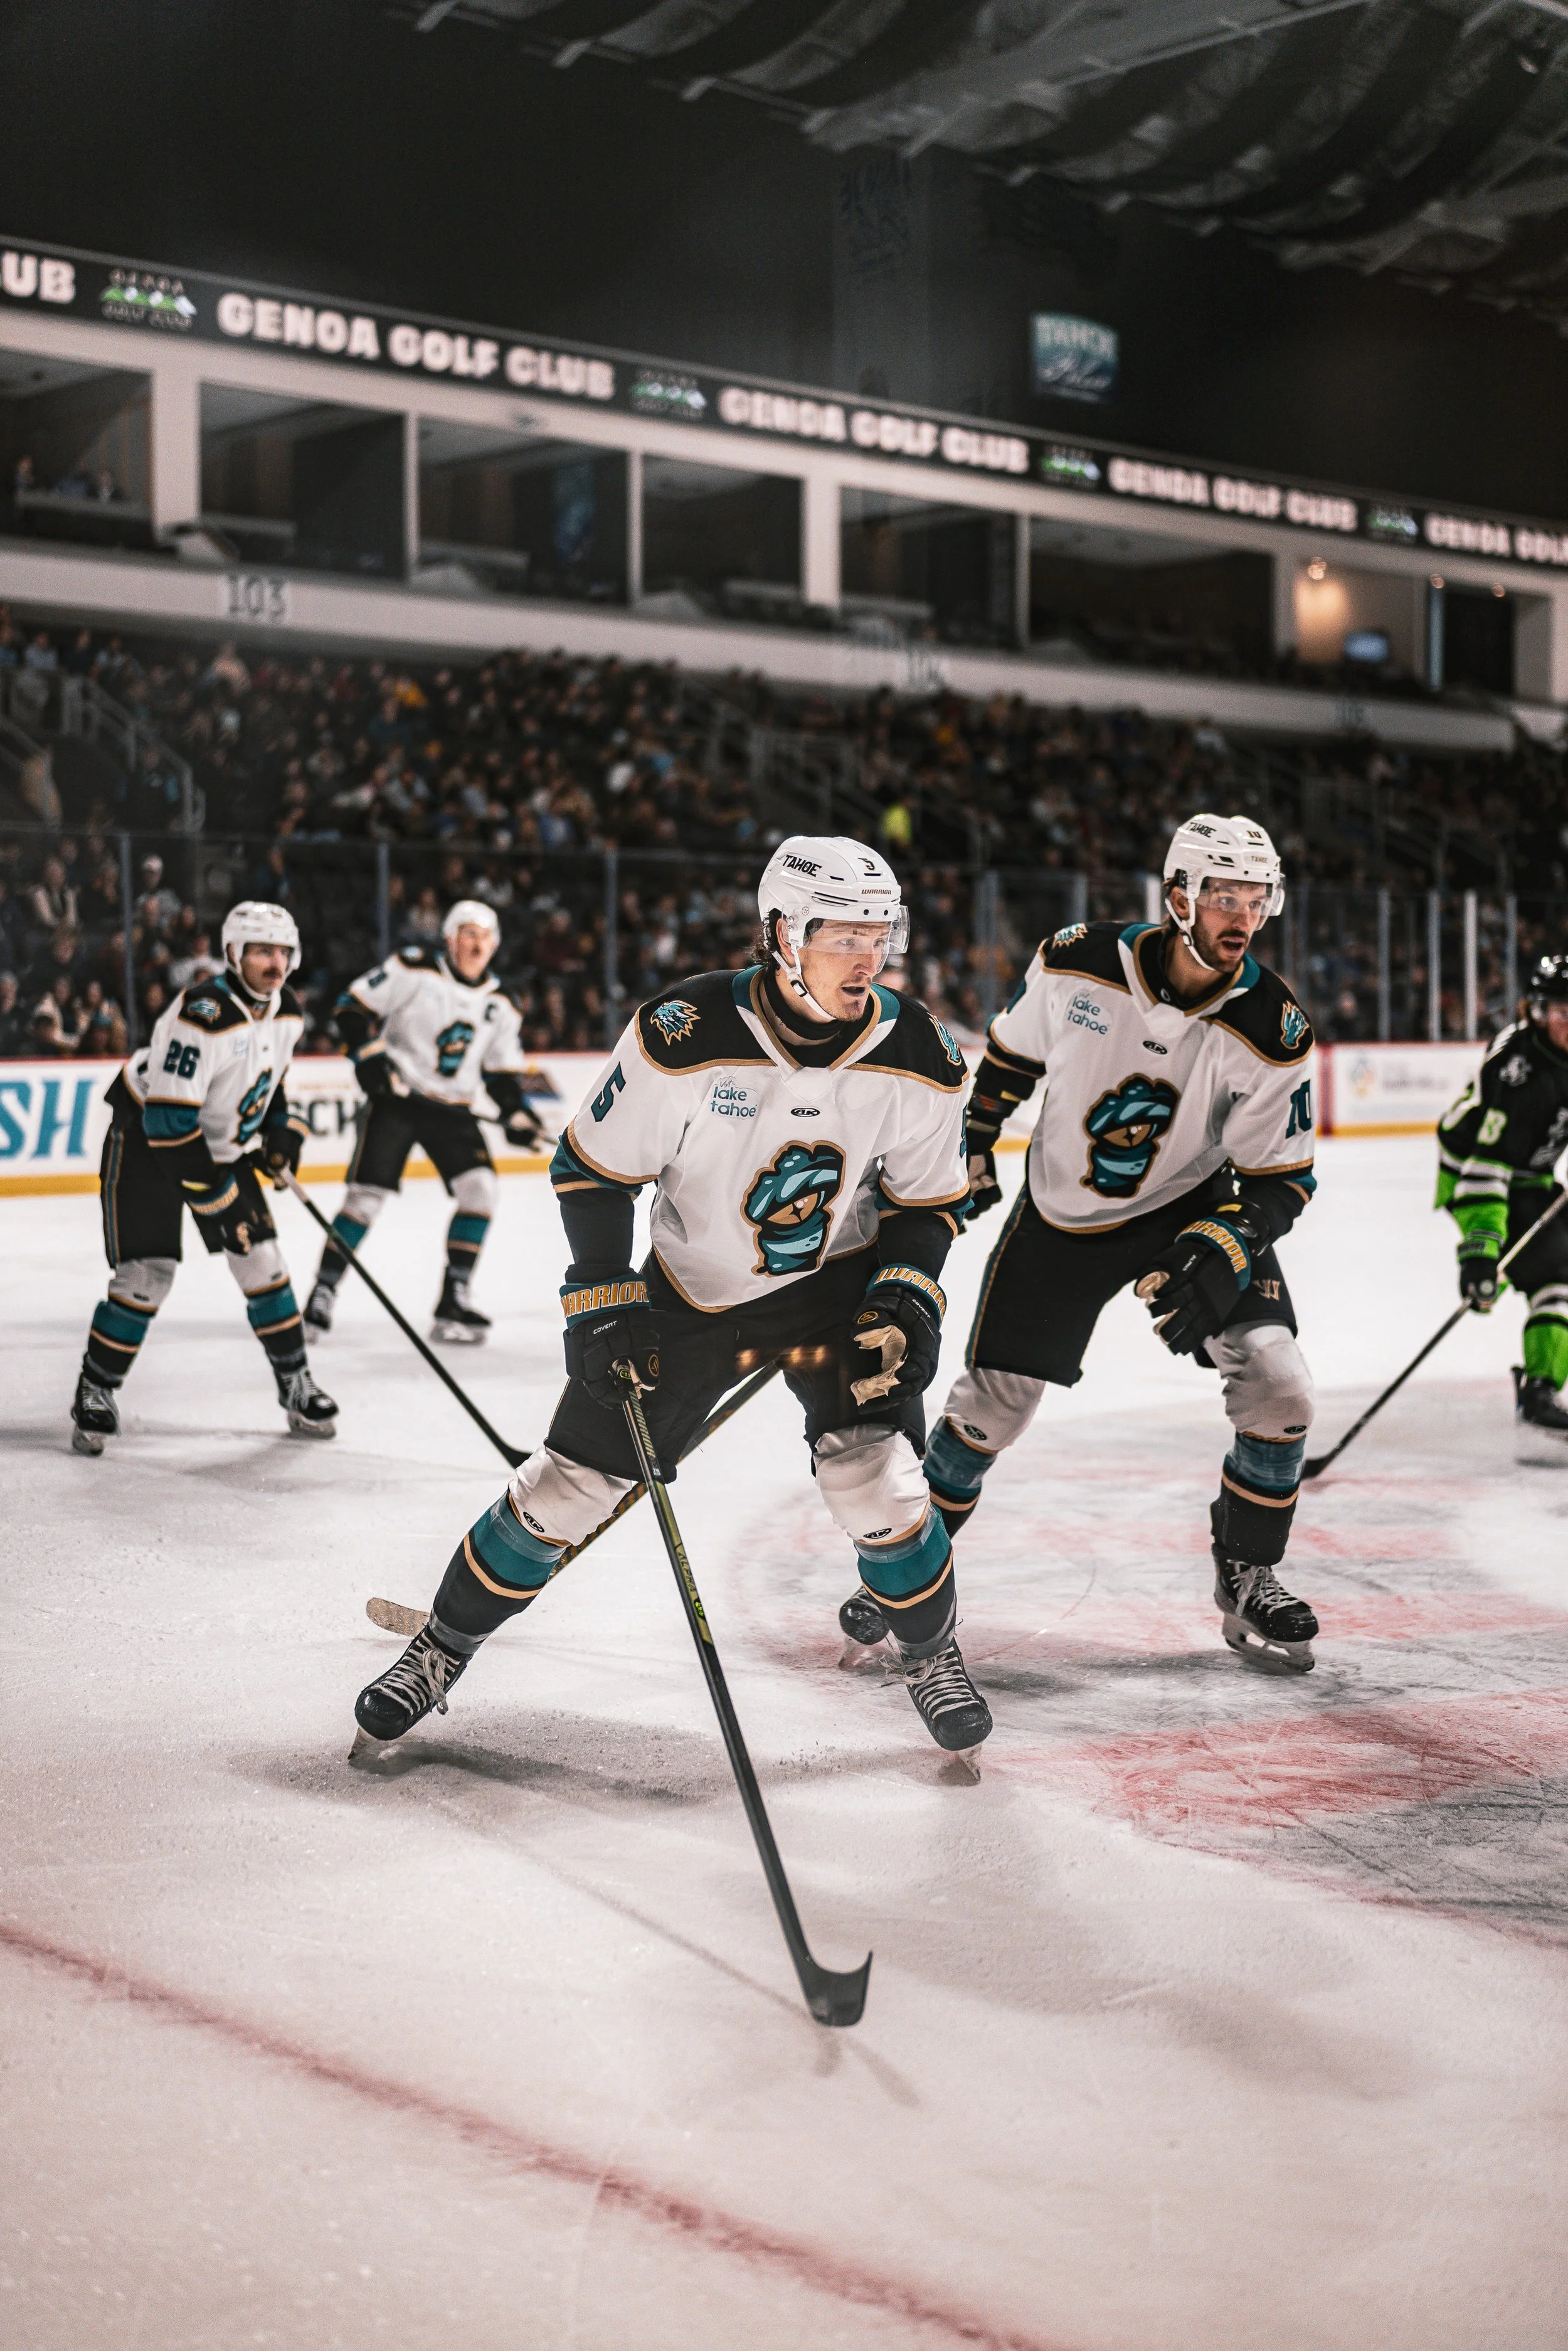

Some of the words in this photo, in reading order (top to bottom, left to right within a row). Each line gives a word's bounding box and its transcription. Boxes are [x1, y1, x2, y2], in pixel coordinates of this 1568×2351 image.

[218, 293, 380, 360] GENOA
[388, 324, 499, 378] GOLF
[506, 346, 615, 401] CLUB
[719, 386, 846, 443] GENOA
[850, 410, 938, 457] GOLF
[942, 427, 1029, 474] CLUB
[1185, 822, 1217, 838] TAHOE
[782, 854, 822, 878] TAHOE
[1251, 855, 1268, 864] TAHOE
[1072, 996, 1100, 1016] lake
[1067, 1010, 1108, 1035] tahoe
[163, 1038, 201, 1081] 26
[590, 1061, 627, 1123] 5
[712, 1086, 748, 1101] lake
[710, 1100, 756, 1118] tahoe
[1285, 1078, 1312, 1140] 10
[911, 1298, 931, 1319] COVERT
[593, 1320, 618, 1335] COVERT
[628, 1390, 656, 1458] WARRIOR
